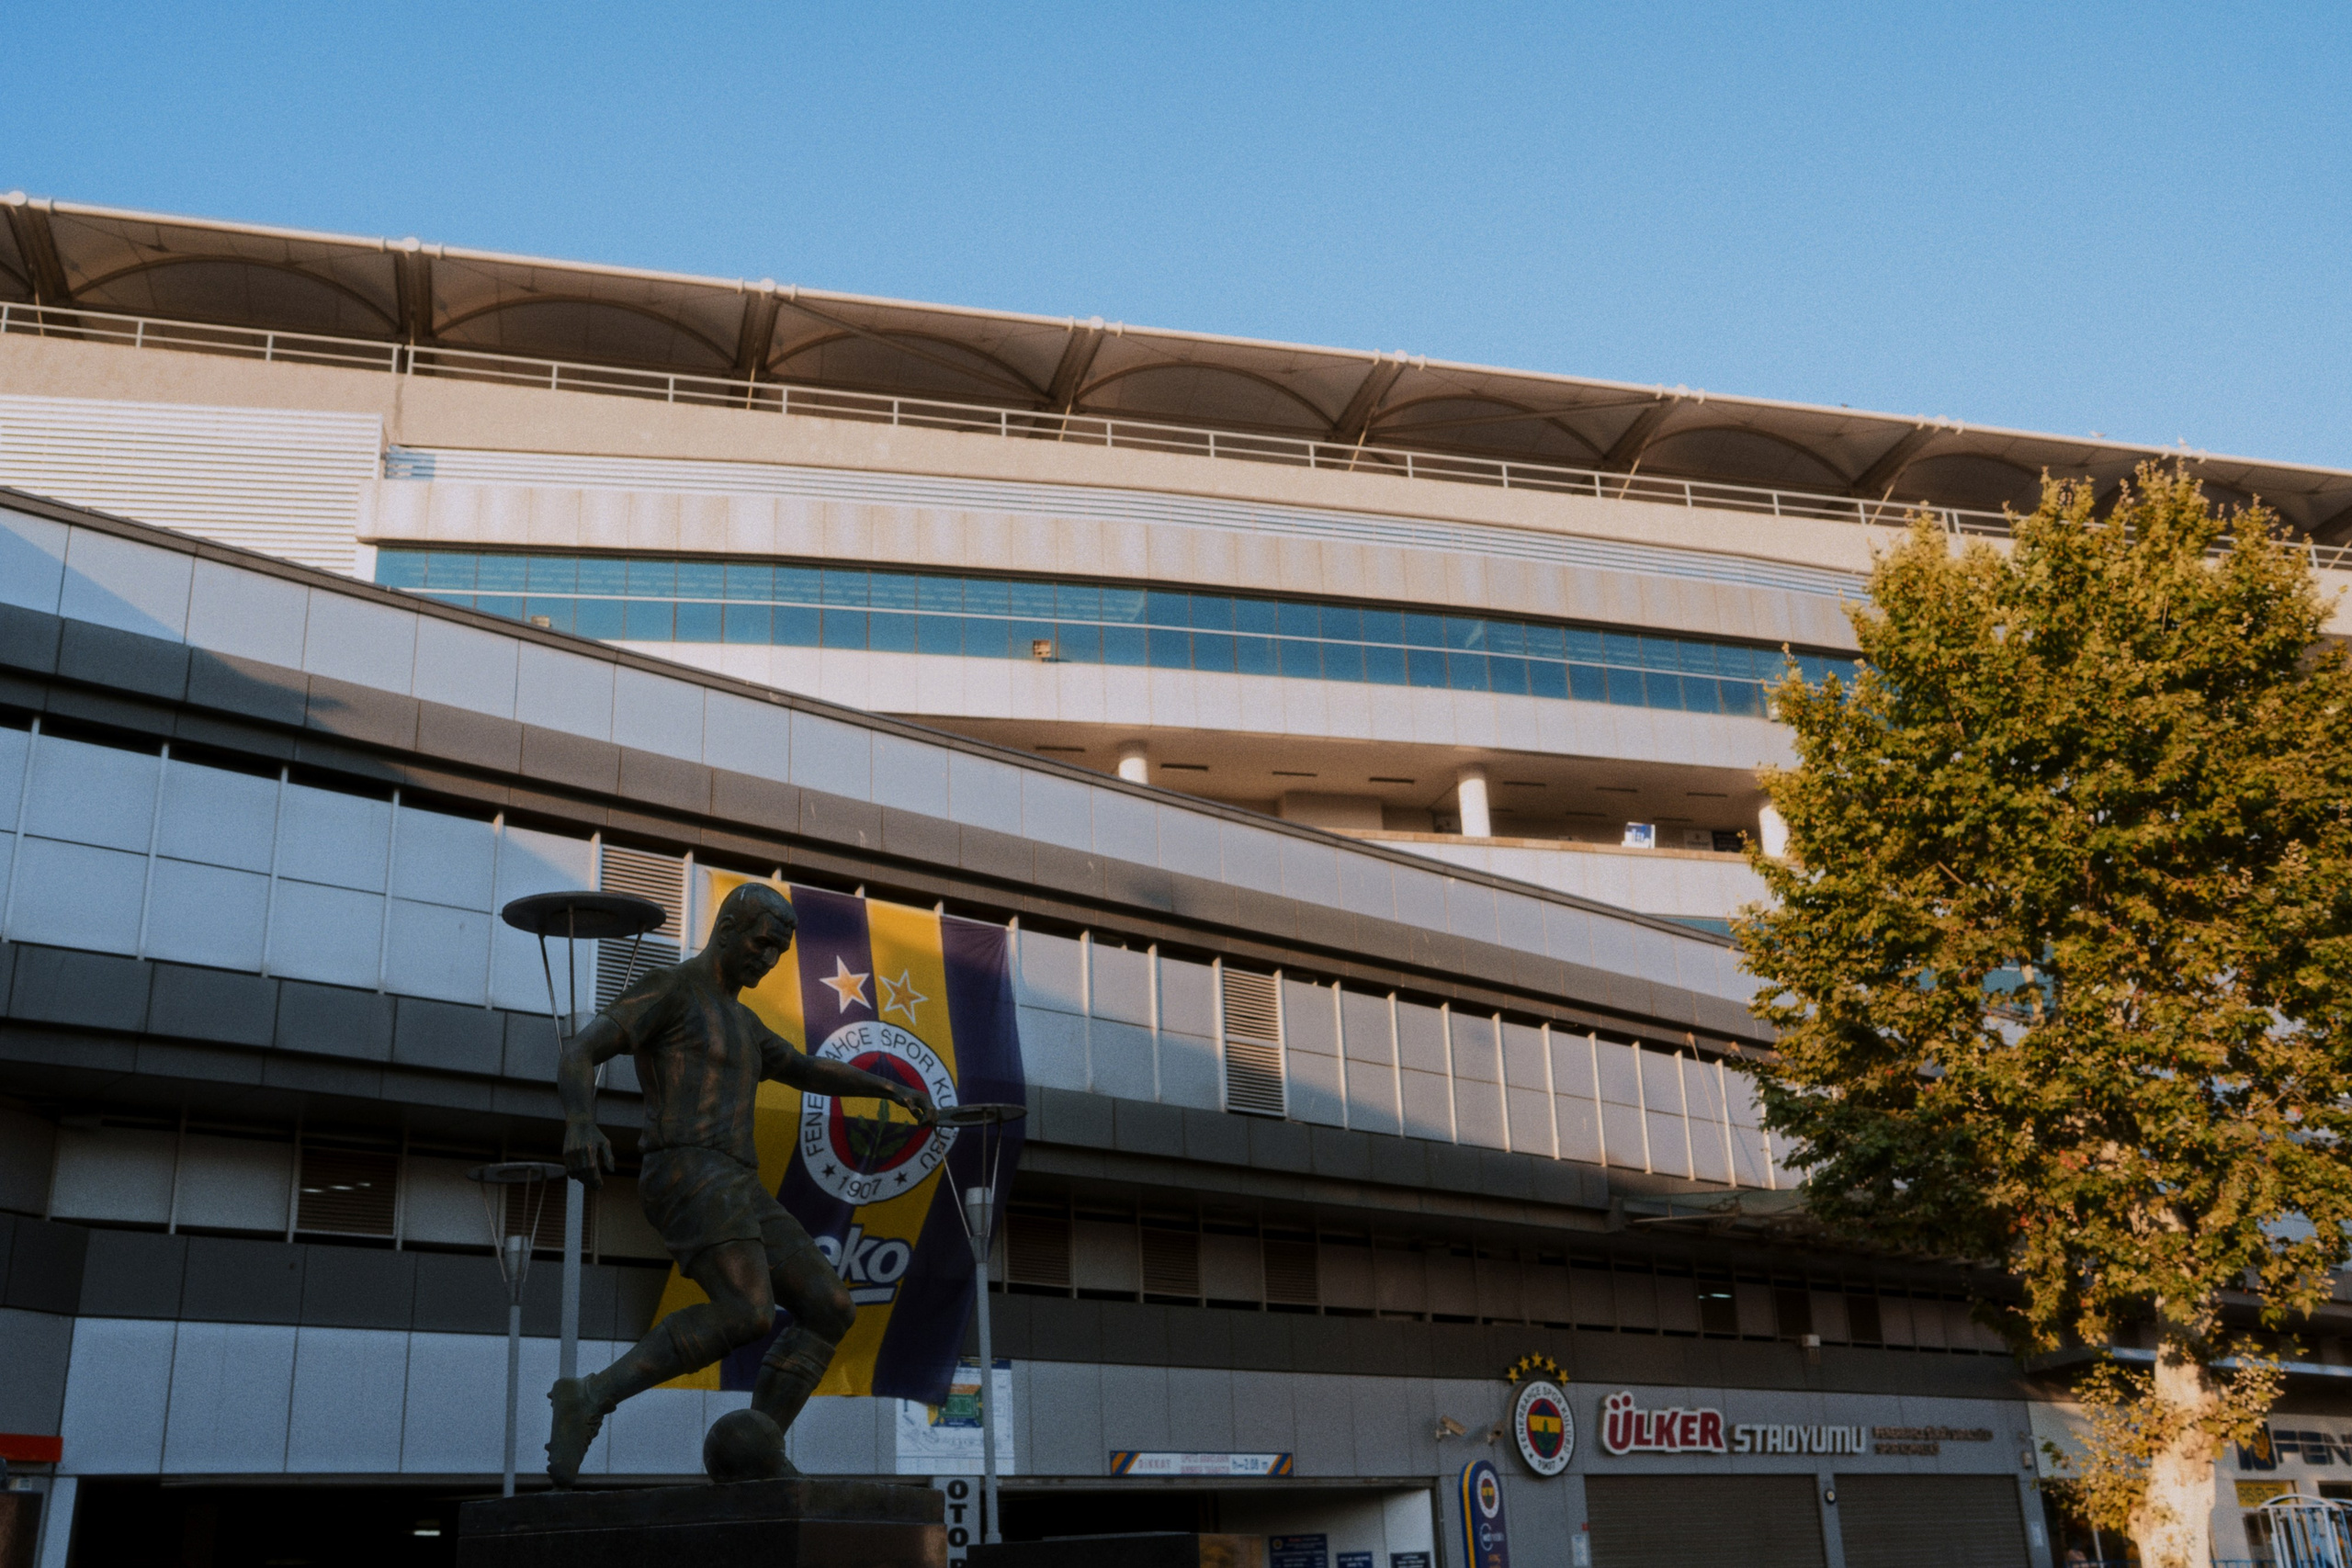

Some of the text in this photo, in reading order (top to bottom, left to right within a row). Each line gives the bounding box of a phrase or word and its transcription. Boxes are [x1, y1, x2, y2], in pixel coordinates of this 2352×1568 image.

[805, 1026, 957, 1170] FENEAHÇE SPOR KUÜBÜ
[837, 1176, 883, 1201] 1907
[812, 1225, 911, 1284] eko
[1605, 1393, 1866, 1454] ÜLKER STADYUMU
